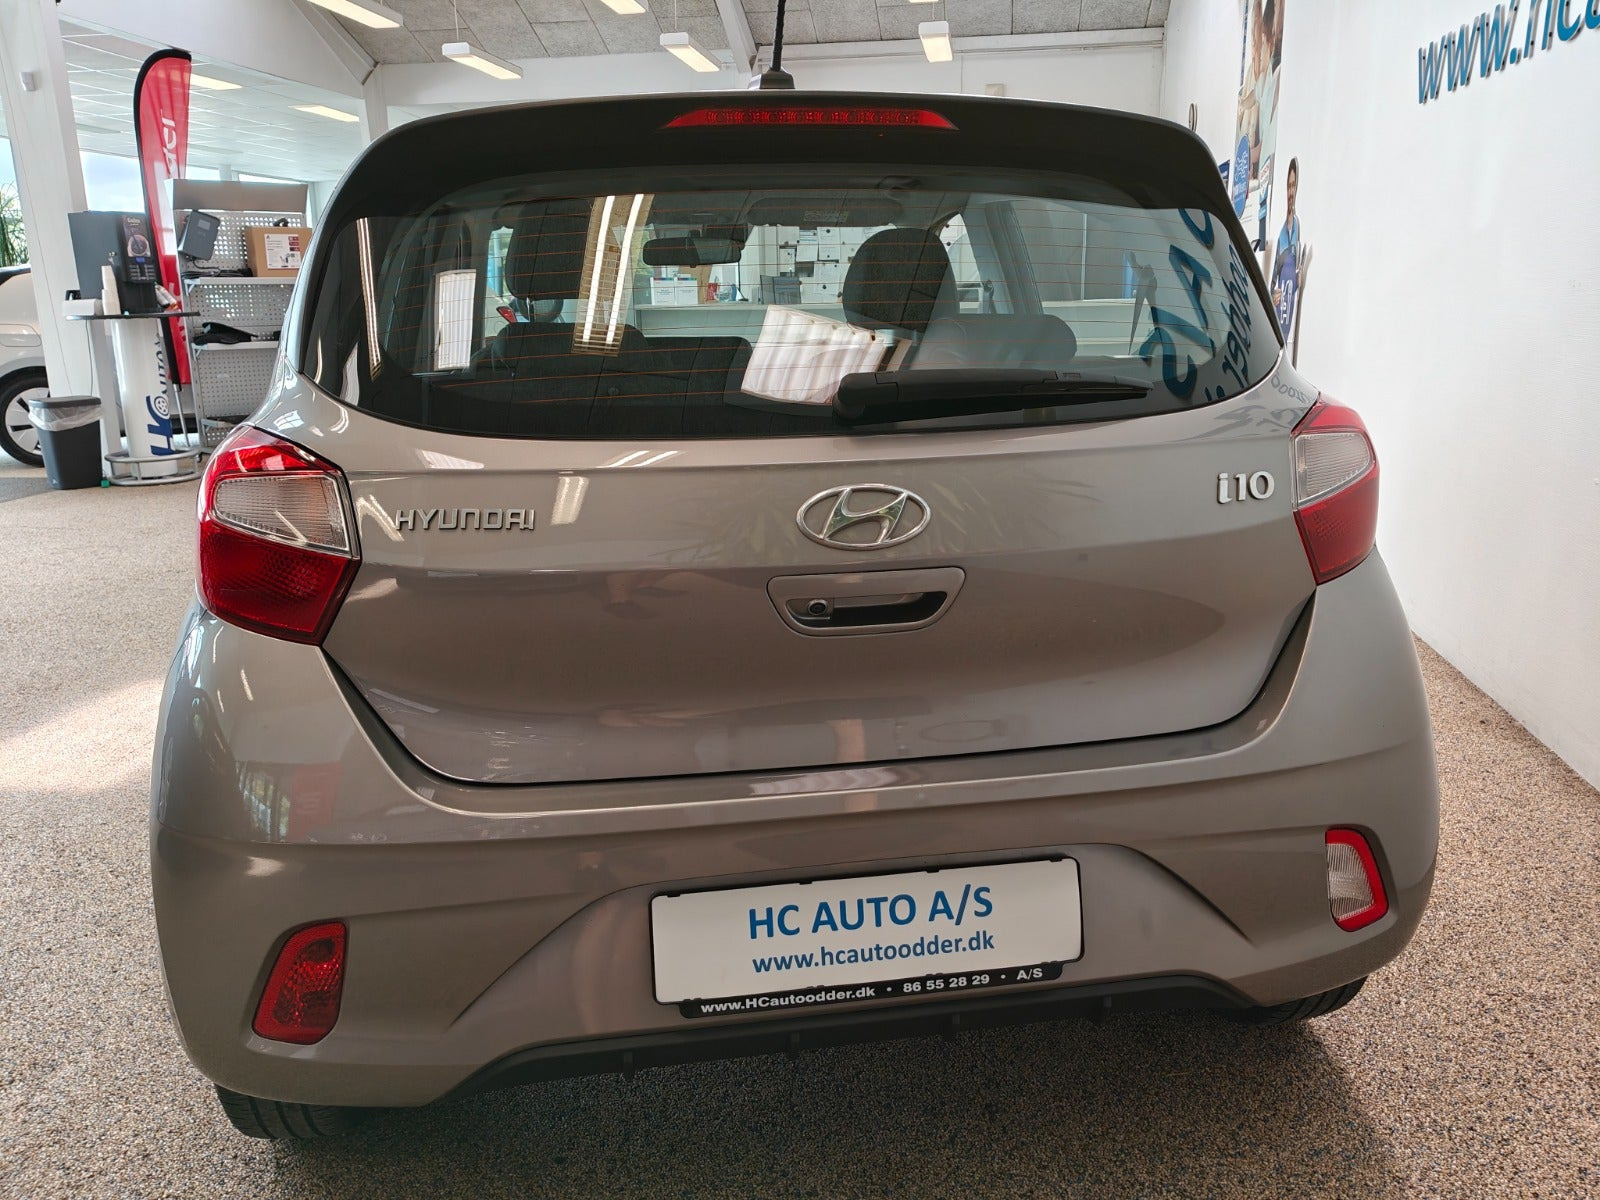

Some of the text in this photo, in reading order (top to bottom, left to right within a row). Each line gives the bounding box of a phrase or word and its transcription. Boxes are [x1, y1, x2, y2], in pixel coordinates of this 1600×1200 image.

[1216, 471, 1275, 504] i10
[395, 508, 535, 530] HYUNDAI
[748, 884, 993, 939] HC AUTO A/S
[752, 930, 995, 973] www.hcautoodder.dk
[700, 967, 1043, 1014] www.HCautoodder.dk 86 55 28 29 A/S
